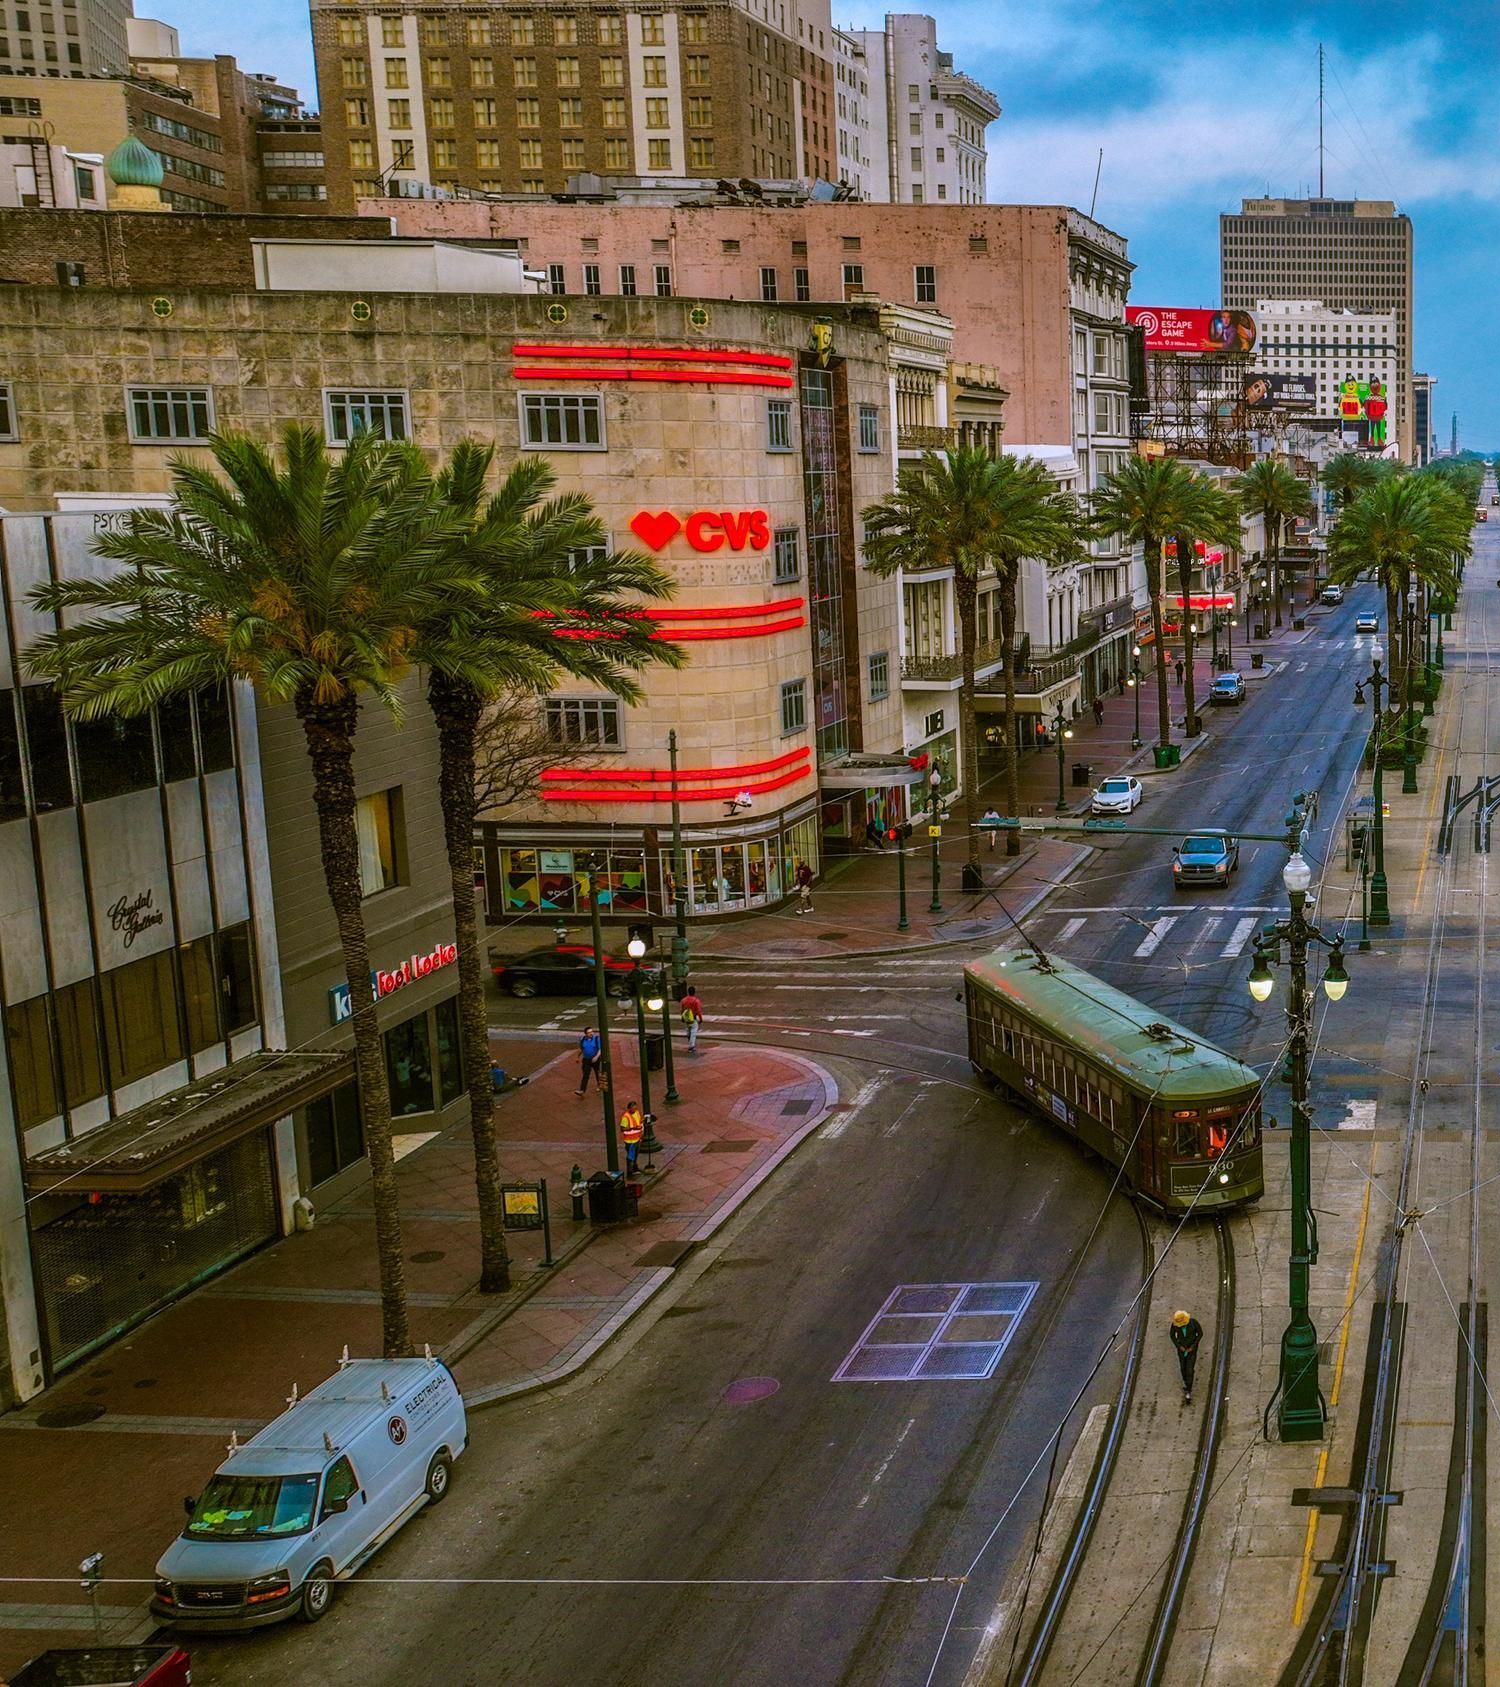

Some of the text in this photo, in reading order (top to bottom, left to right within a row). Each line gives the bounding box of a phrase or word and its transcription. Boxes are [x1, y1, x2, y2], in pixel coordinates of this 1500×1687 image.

[1161, 312, 1177, 320] THE
[1161, 321, 1193, 329] ESCAPE
[1161, 329, 1185, 337] GAME
[685, 510, 770, 553] CVS
[107, 888, 153, 931] Crystal
[376, 961, 411, 998] Foot
[410, 942, 459, 979] Locke
[404, 1374, 447, 1414] ELECTRICAL
